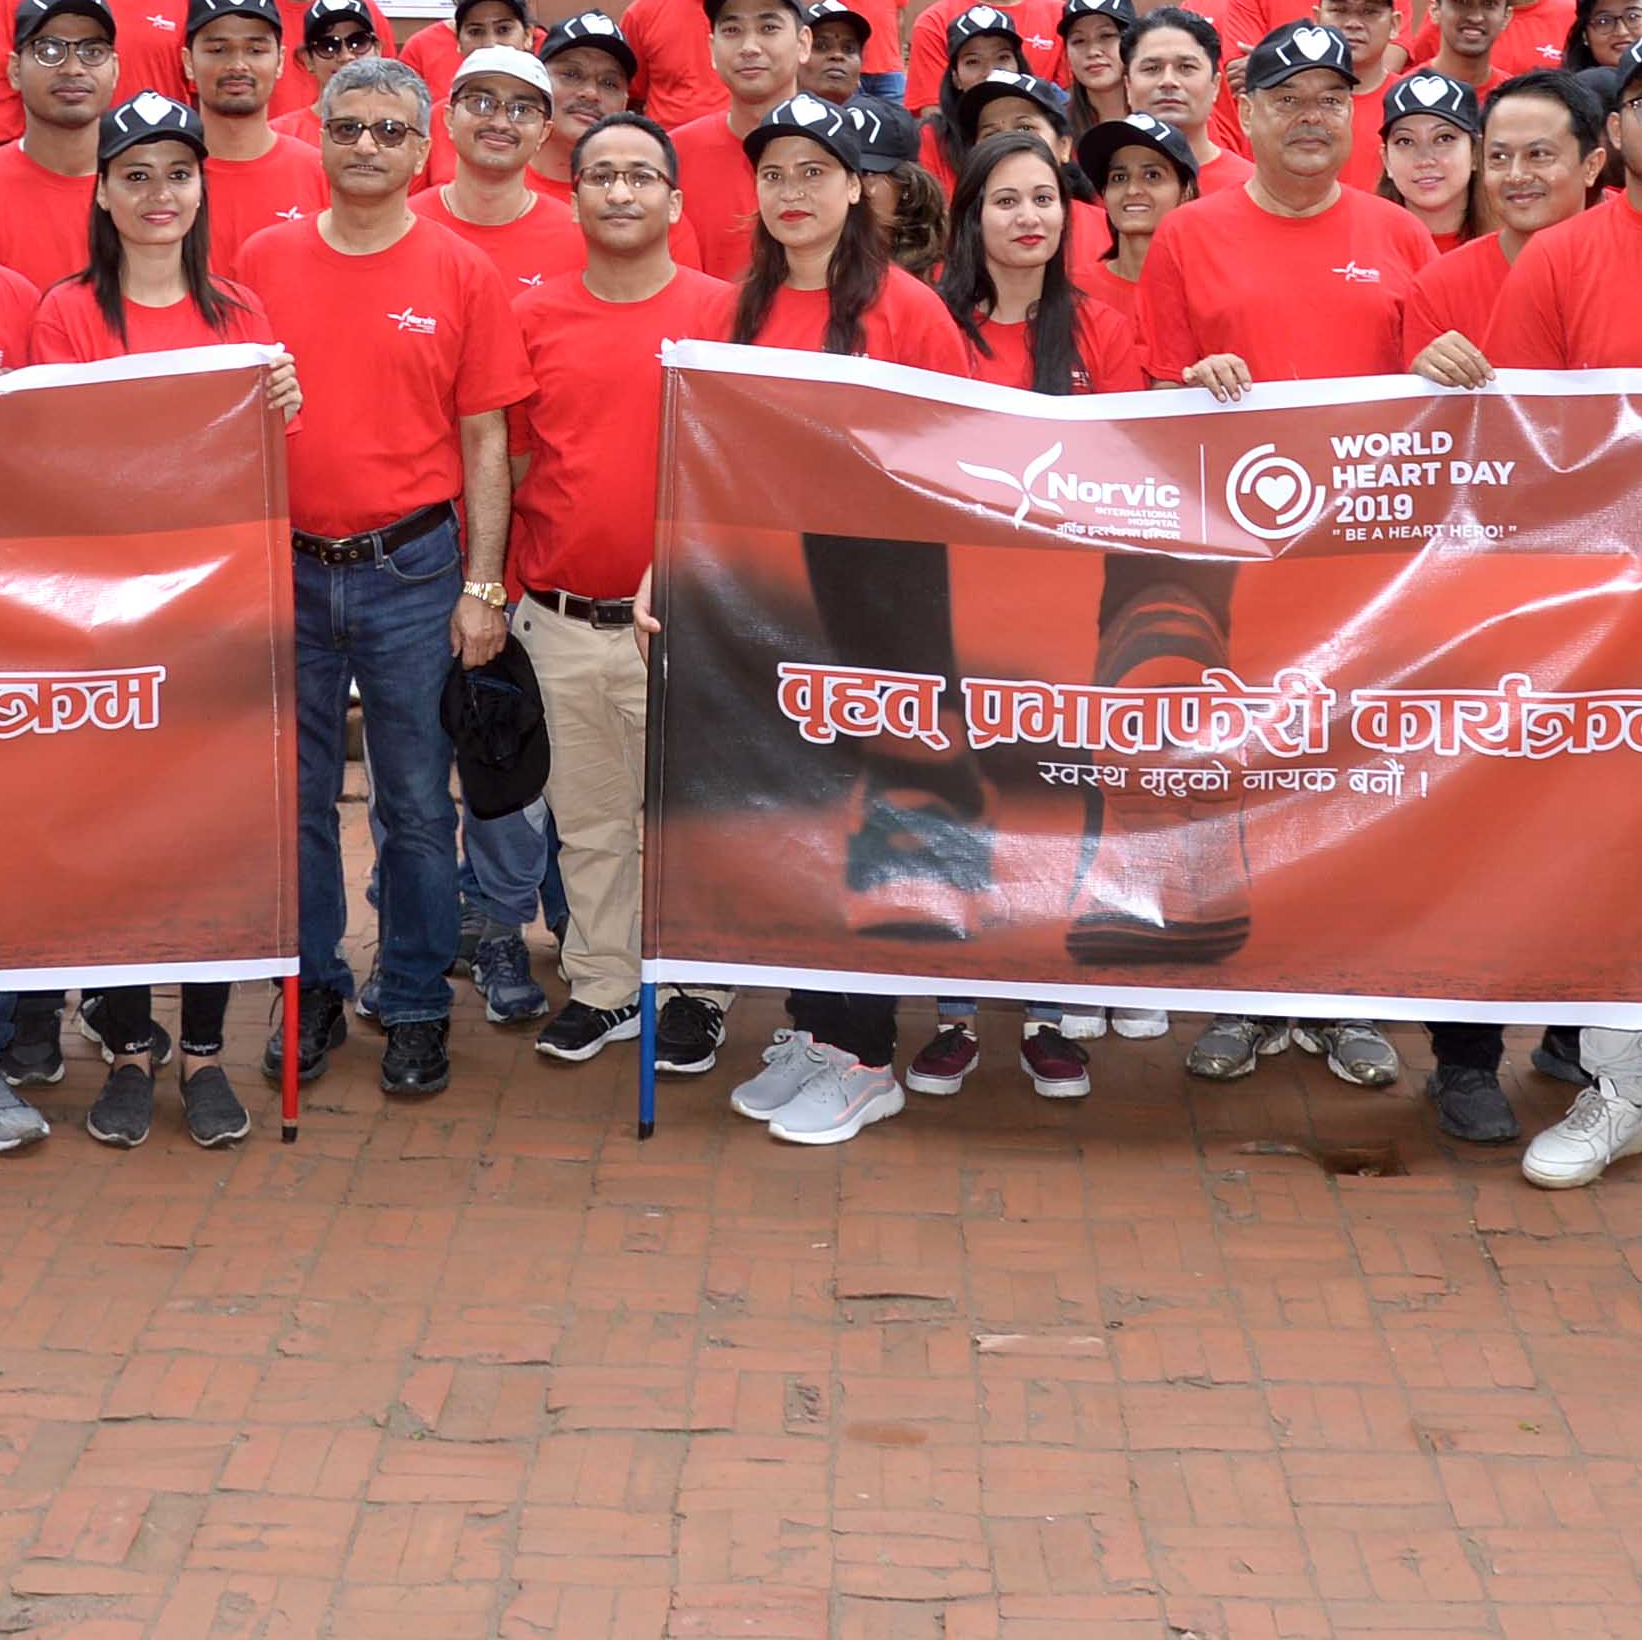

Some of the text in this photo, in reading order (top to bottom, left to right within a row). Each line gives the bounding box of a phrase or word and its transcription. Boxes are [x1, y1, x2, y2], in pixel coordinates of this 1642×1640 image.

[1330, 431, 1453, 459] WORLD
[1047, 472, 1181, 508] Norvic
[1332, 461, 1515, 489] HEART DAY
[1335, 493, 1413, 523] 2019
[1371, 527, 1384, 540] A
[1389, 525, 1444, 539] HEART
[962, 667, 1336, 756] प्रभातफेरी
[1038, 761, 1127, 789] स्वस्थ
[1138, 760, 1231, 798] मुटुको
[1242, 767, 1338, 793] नायक
[1348, 760, 1405, 796] बनौं
